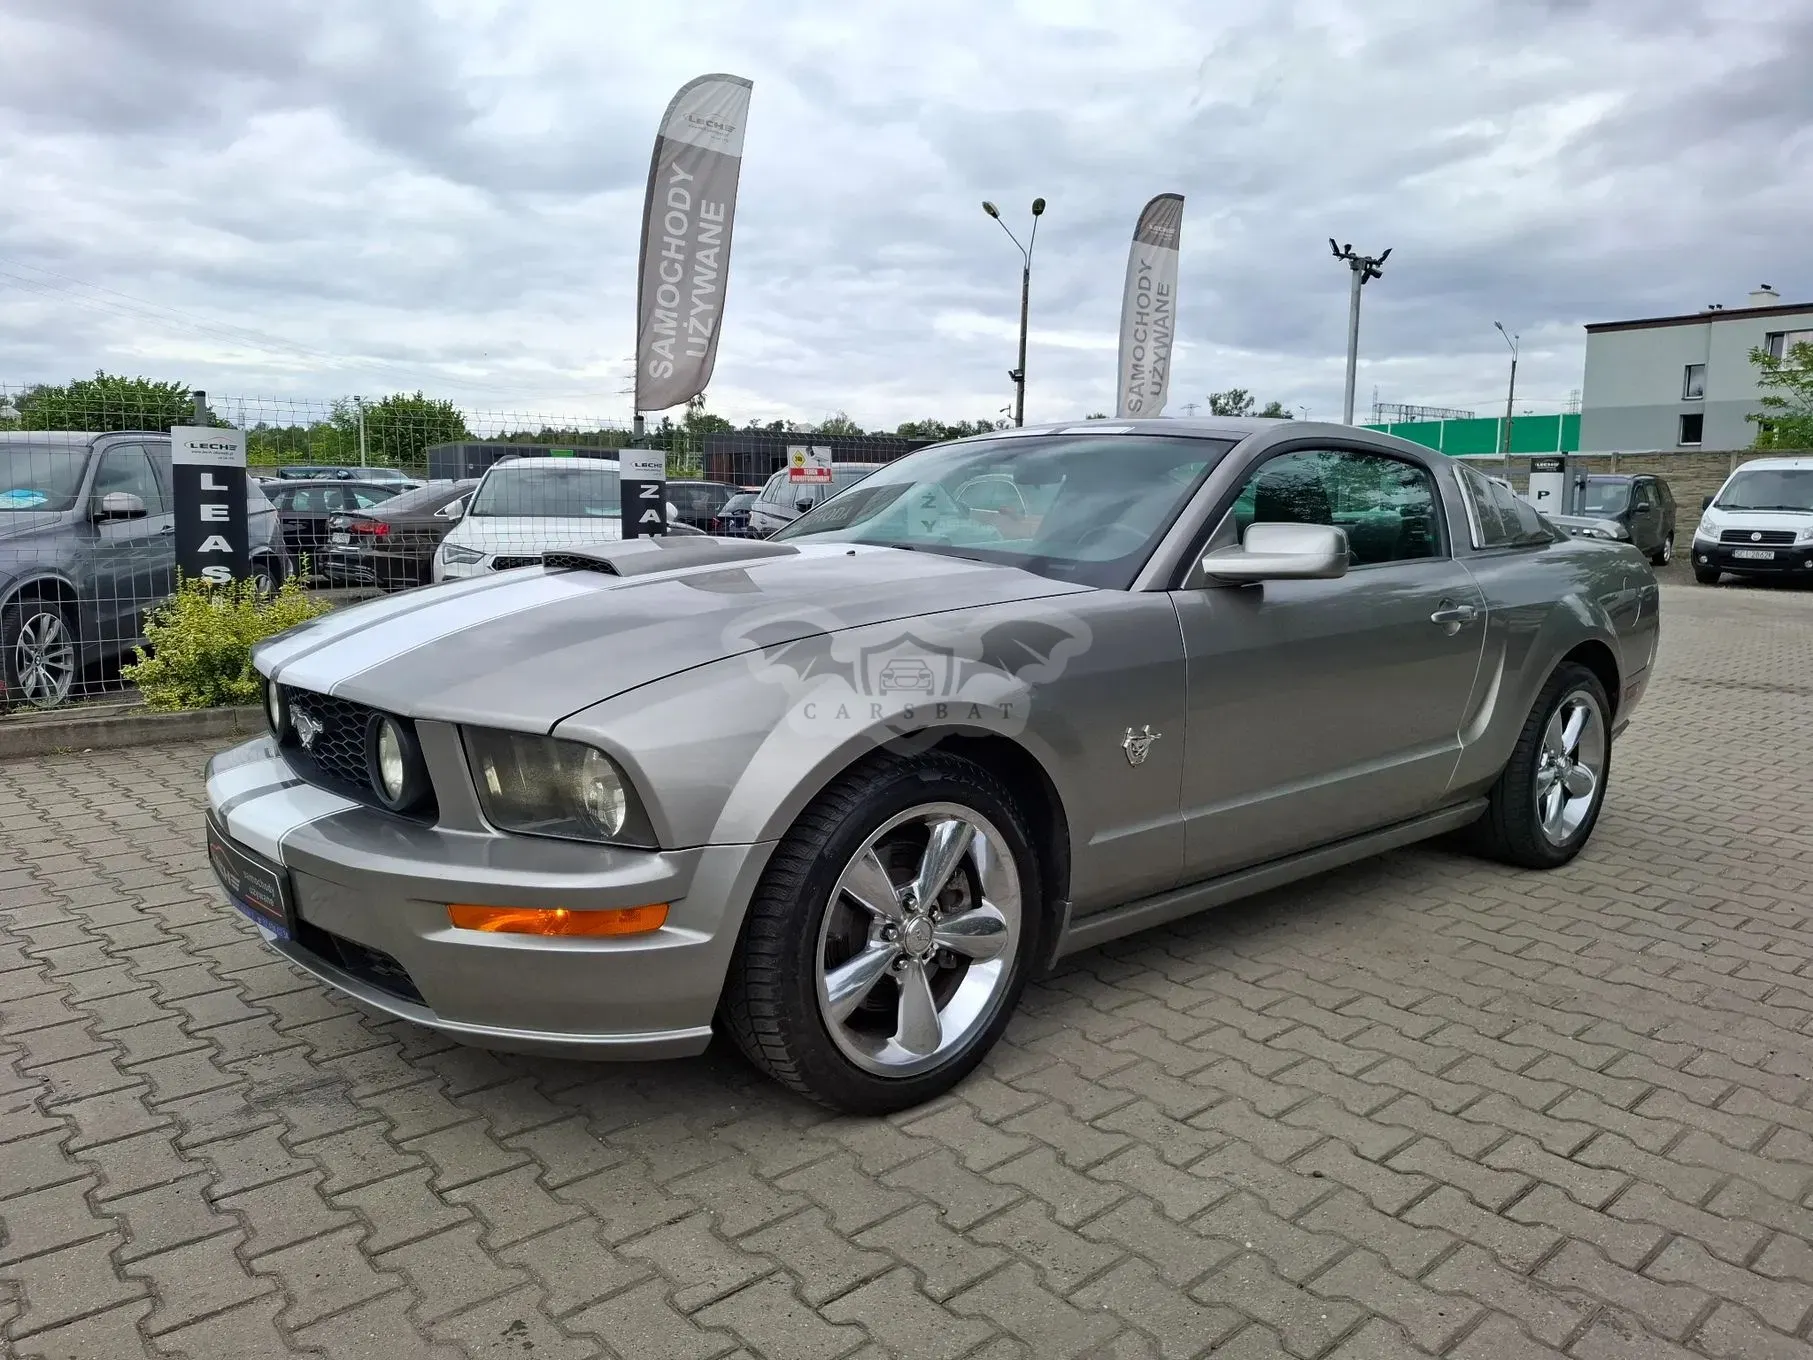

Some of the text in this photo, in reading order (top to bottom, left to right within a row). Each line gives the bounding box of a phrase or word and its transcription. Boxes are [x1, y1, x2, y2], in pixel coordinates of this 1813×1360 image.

[649, 162, 694, 379] SAMOCHODY
[683, 199, 725, 358] UŻYWANE
[1128, 258, 1153, 414] SAMOCHODY
[1148, 282, 1170, 397] UŻYWANE
